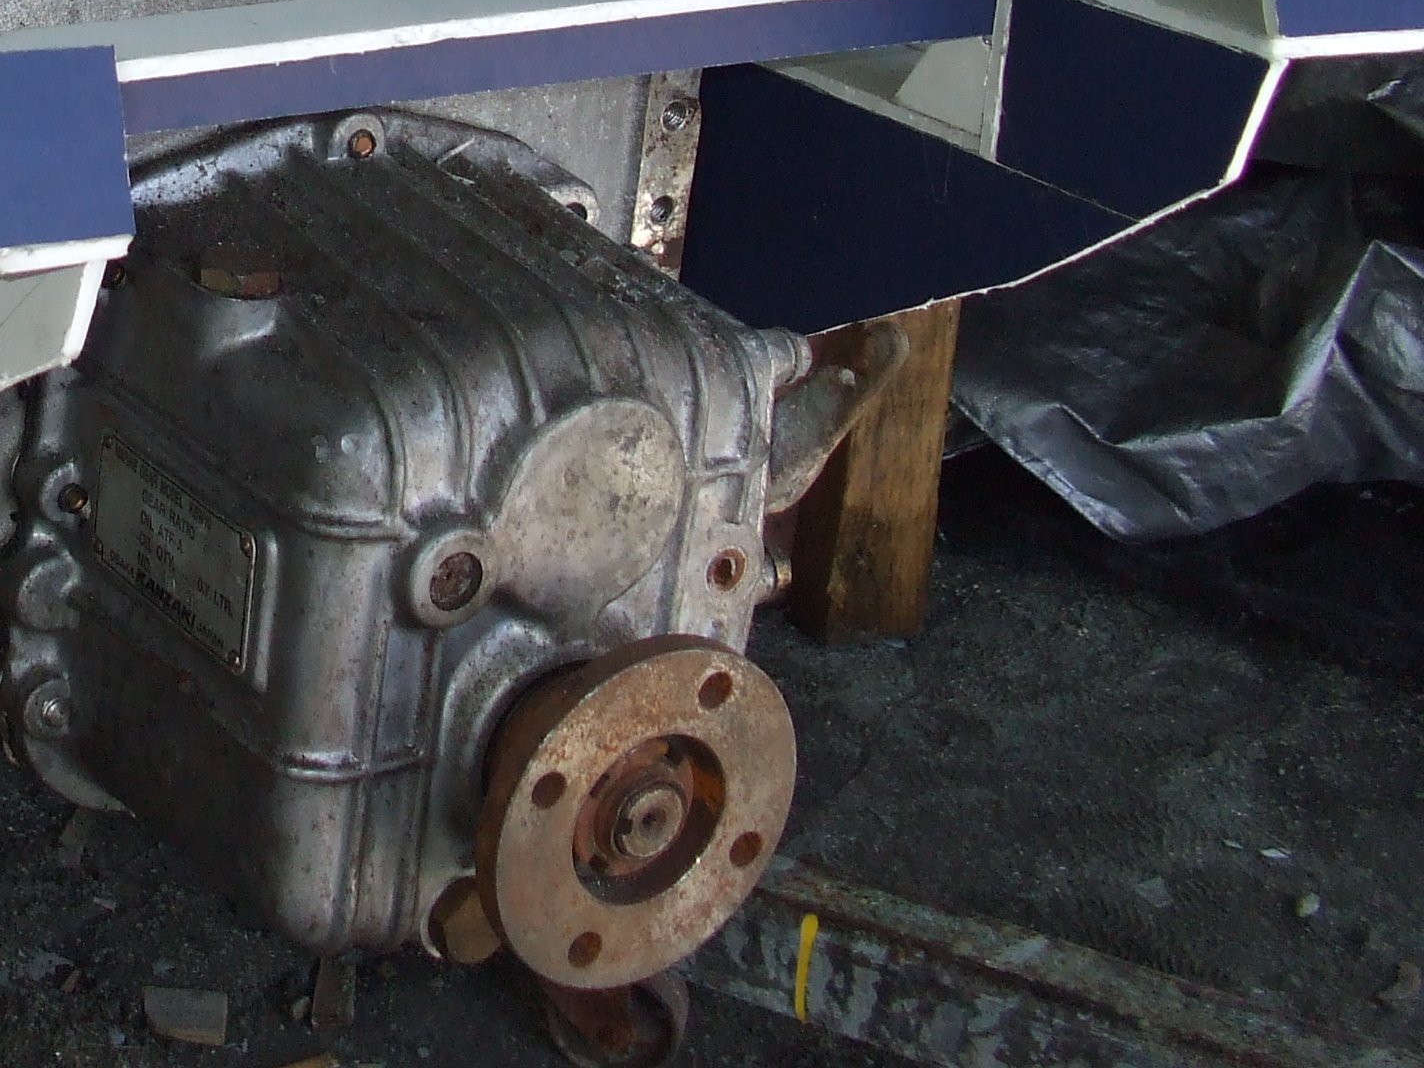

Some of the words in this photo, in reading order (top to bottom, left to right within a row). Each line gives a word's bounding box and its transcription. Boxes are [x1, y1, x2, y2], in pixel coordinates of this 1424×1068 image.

[139, 509, 154, 532] OIL
[141, 487, 165, 518] GEAR
[168, 507, 195, 542] RATIO
[135, 566, 195, 628] KANZAKI
